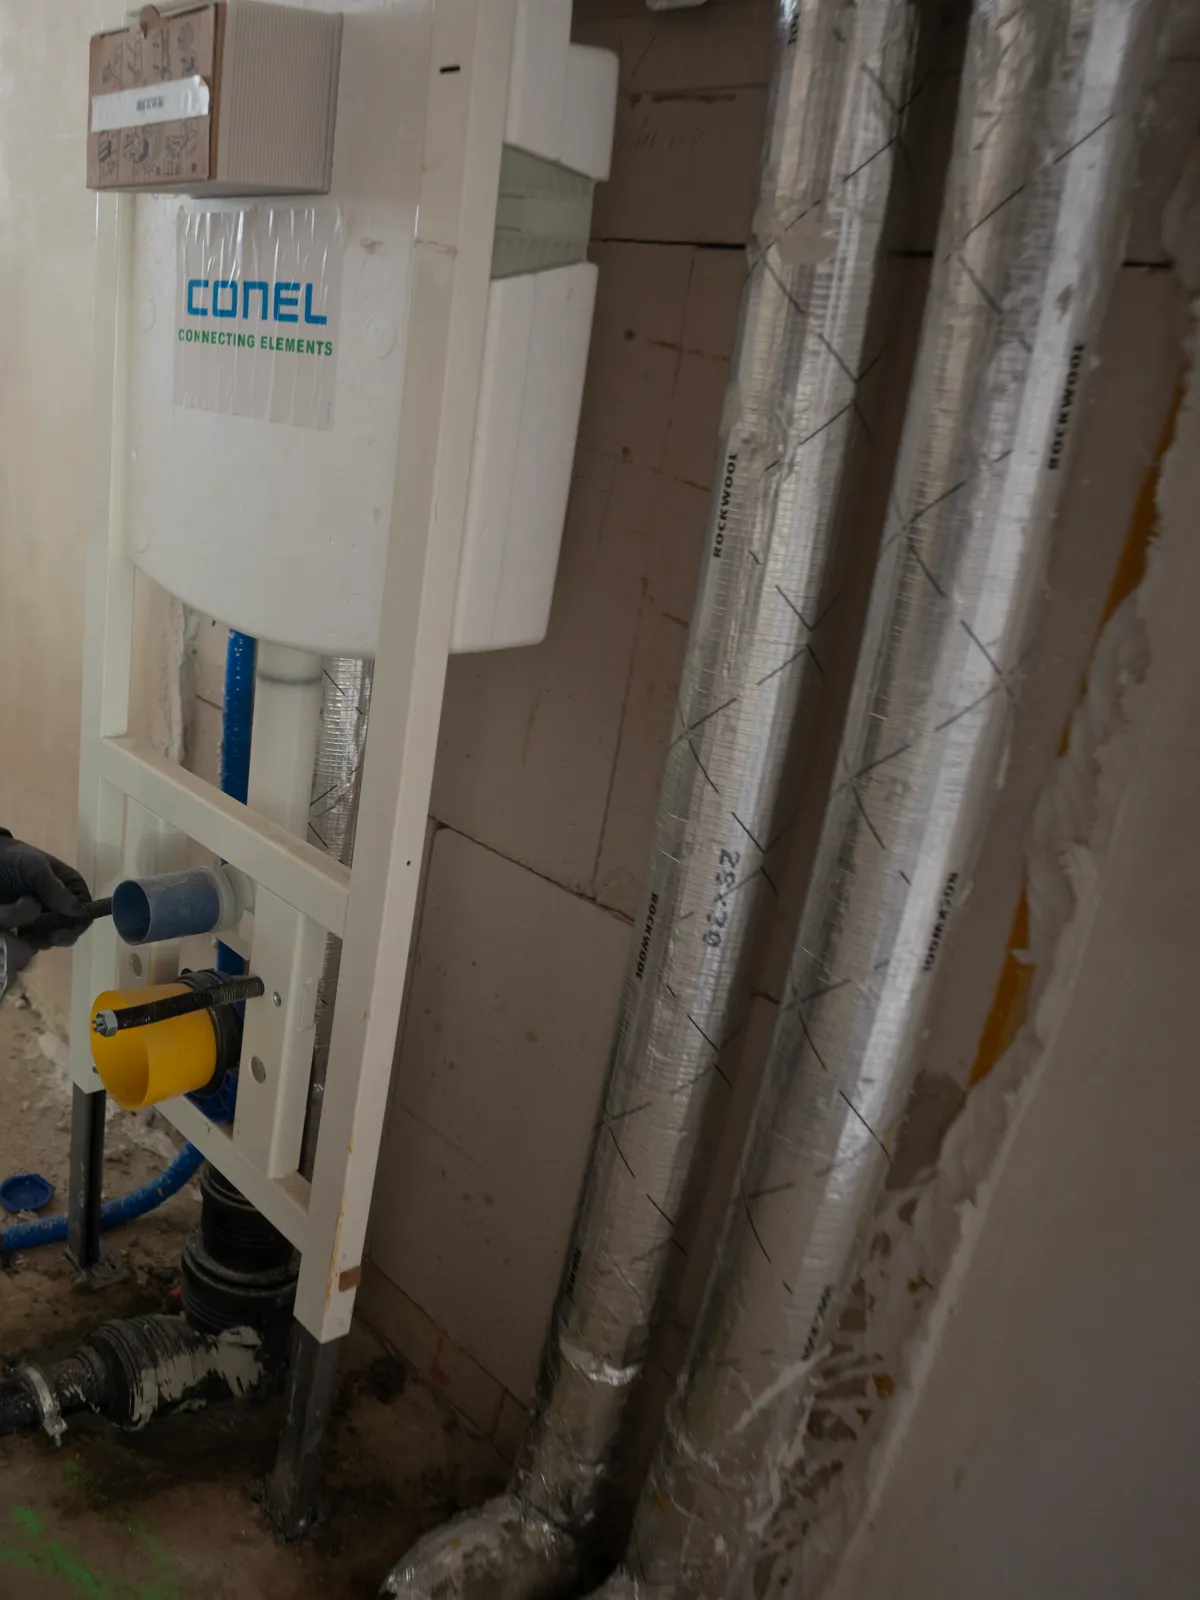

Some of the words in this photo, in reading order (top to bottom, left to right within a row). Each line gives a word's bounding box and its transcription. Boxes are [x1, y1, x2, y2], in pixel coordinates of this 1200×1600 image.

[178, 328, 255, 348] CONNECTING
[260, 336, 333, 356] ELEMENTS
[187, 279, 327, 325] CONEL
[1048, 343, 1085, 470] ROCKWOOL
[712, 452, 738, 559] ROCKWOOL
[636, 891, 659, 981] ROCKWOOL
